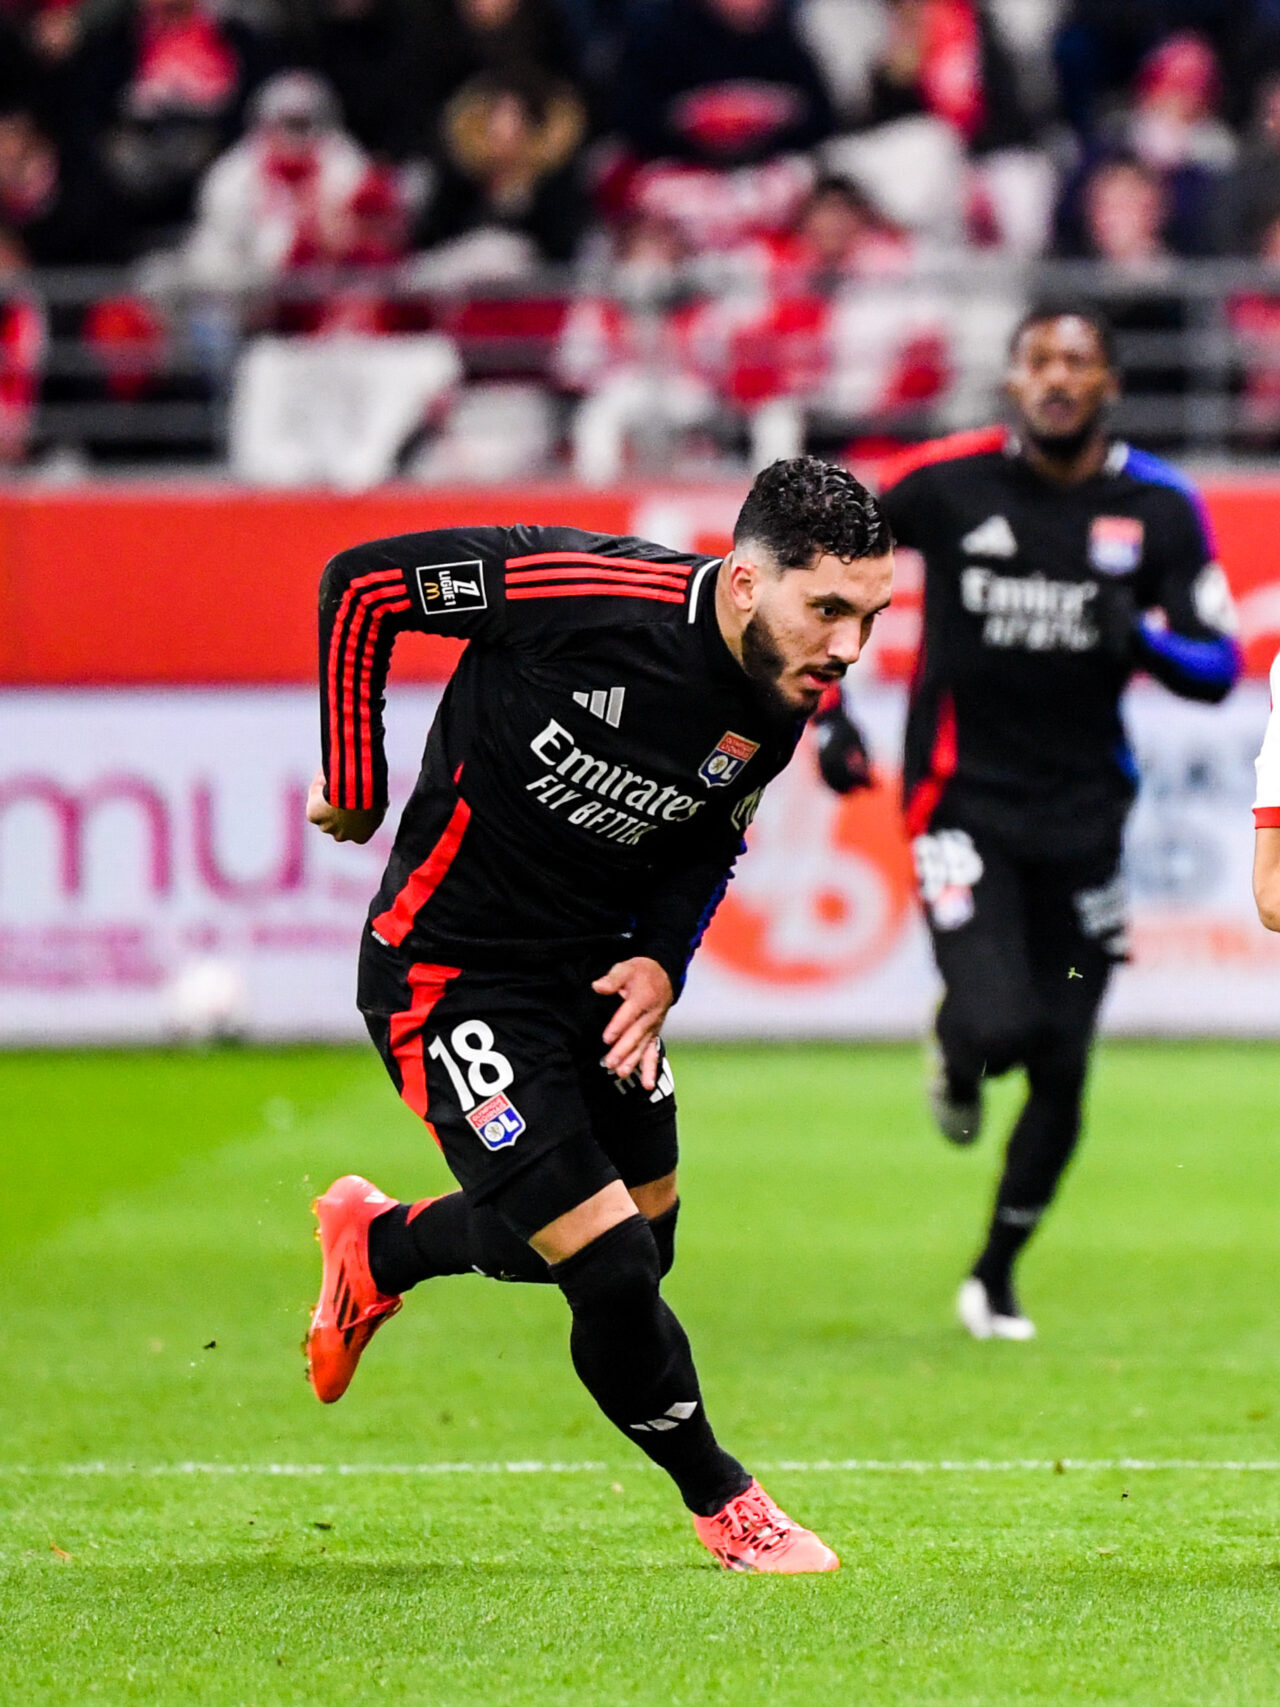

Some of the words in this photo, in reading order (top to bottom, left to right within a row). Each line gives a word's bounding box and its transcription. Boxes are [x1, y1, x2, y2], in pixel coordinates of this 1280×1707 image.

[525, 773, 583, 811] FLY
[567, 800, 659, 846] BETTER
[529, 717, 706, 823] Emirates
[427, 1019, 515, 1112] 18
